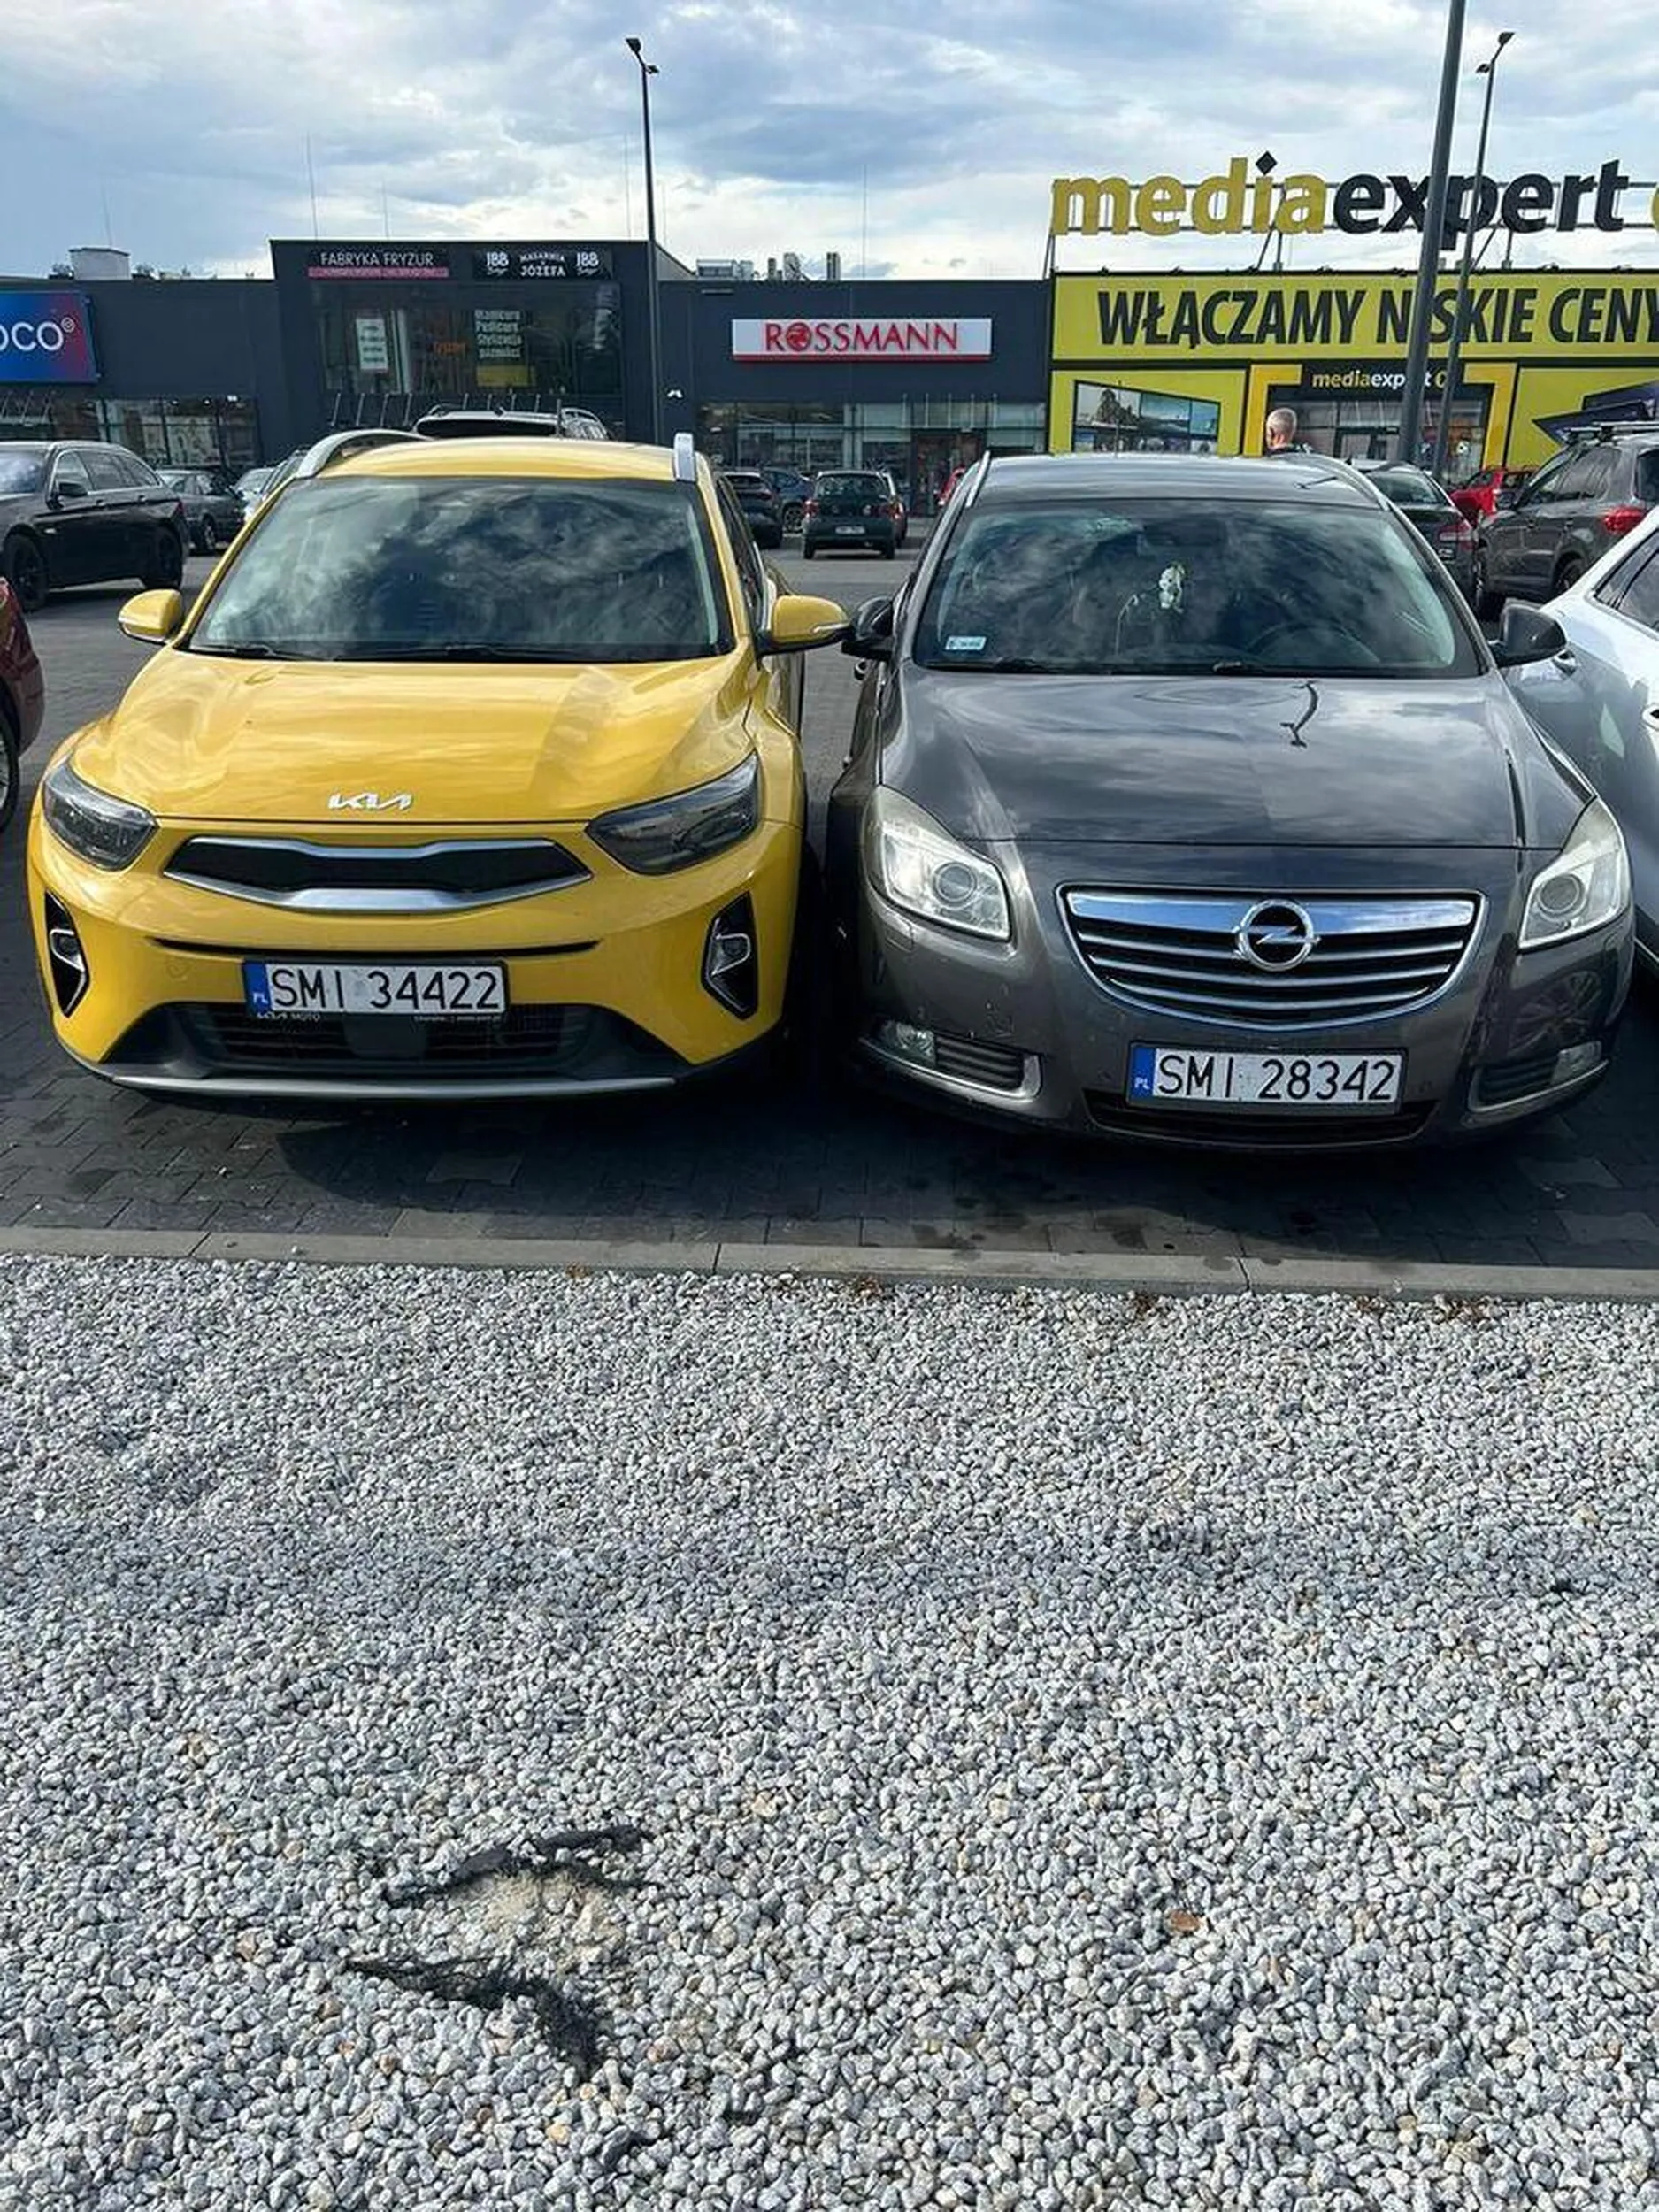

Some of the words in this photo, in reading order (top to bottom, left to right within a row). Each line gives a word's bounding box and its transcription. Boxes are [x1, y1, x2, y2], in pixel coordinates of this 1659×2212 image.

[320, 251, 380, 265] FABRYKA
[383, 251, 434, 265] FRYZUR
[1097, 289, 1367, 349] WŁĄCZAMY
[1376, 288, 1538, 343] NSKIE
[765, 321, 958, 352] ROSSMANN
[1312, 370, 1432, 390] mediaexpt
[271, 968, 344, 1009] SMI
[367, 970, 499, 1010] 34422
[1134, 1076, 1150, 1090] PL
[1158, 1055, 1233, 1098] SMI
[1258, 1058, 1394, 1100] 28342
